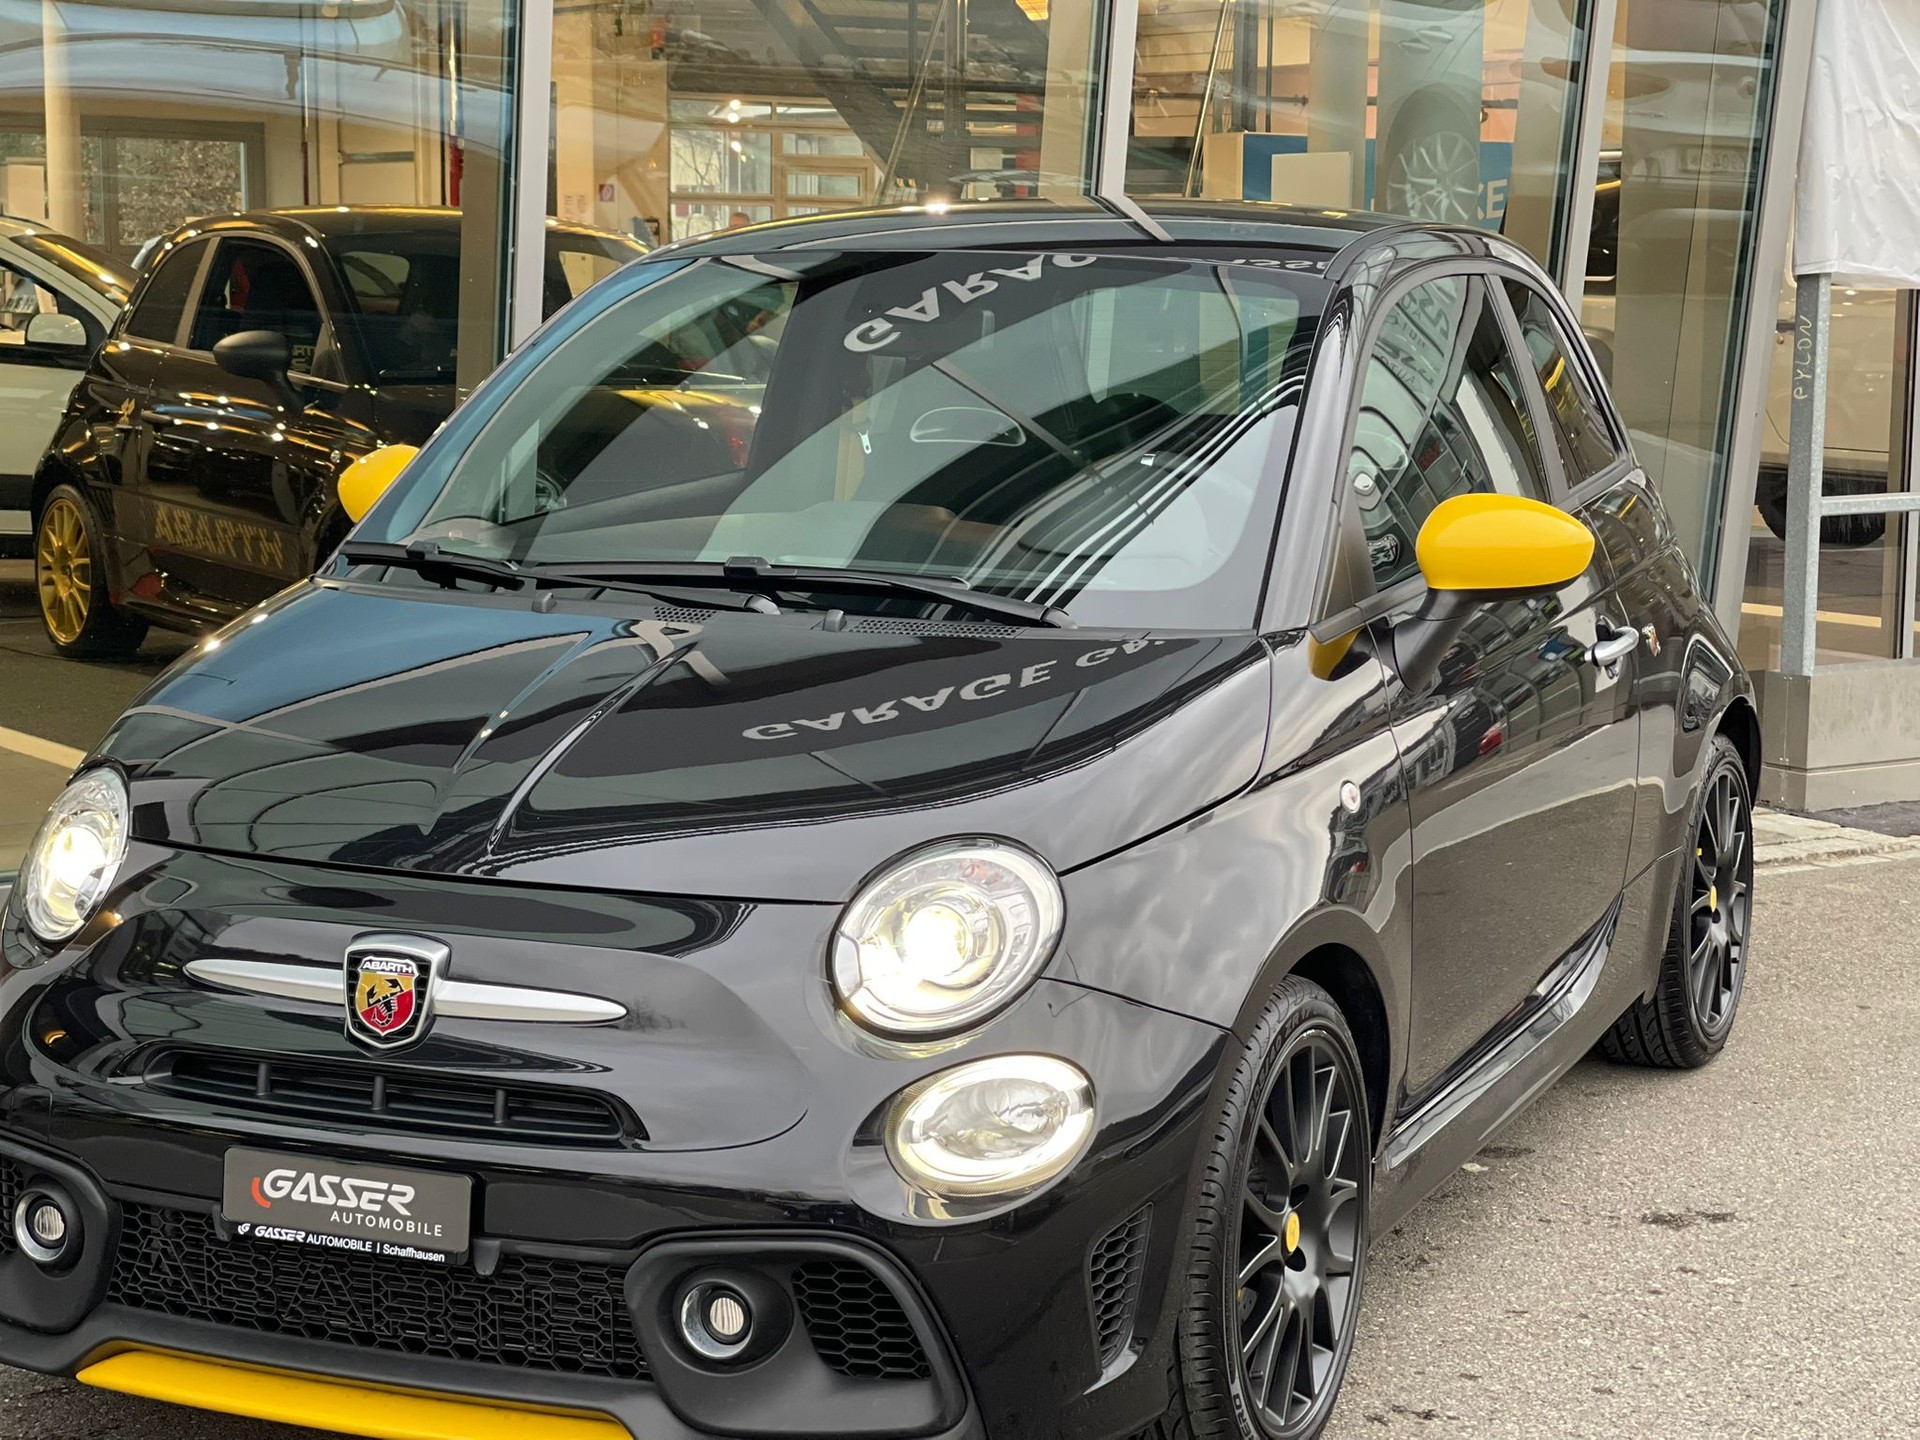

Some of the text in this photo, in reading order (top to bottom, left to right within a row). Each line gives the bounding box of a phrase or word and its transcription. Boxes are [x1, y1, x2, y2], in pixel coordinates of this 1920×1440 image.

[1793, 314, 1812, 400] PYLON
[155, 505, 284, 569] ABARTH
[363, 961, 412, 974] ABARTH
[263, 1168, 415, 1216] GASSER
[255, 1225, 305, 1242] GASSER
[306, 1234, 372, 1253] AUTOMOBILE
[383, 1243, 445, 1263] Schaffhausen
[330, 1210, 443, 1237] AUTOMOBILE
[127, 1235, 617, 1363] ABARTH
